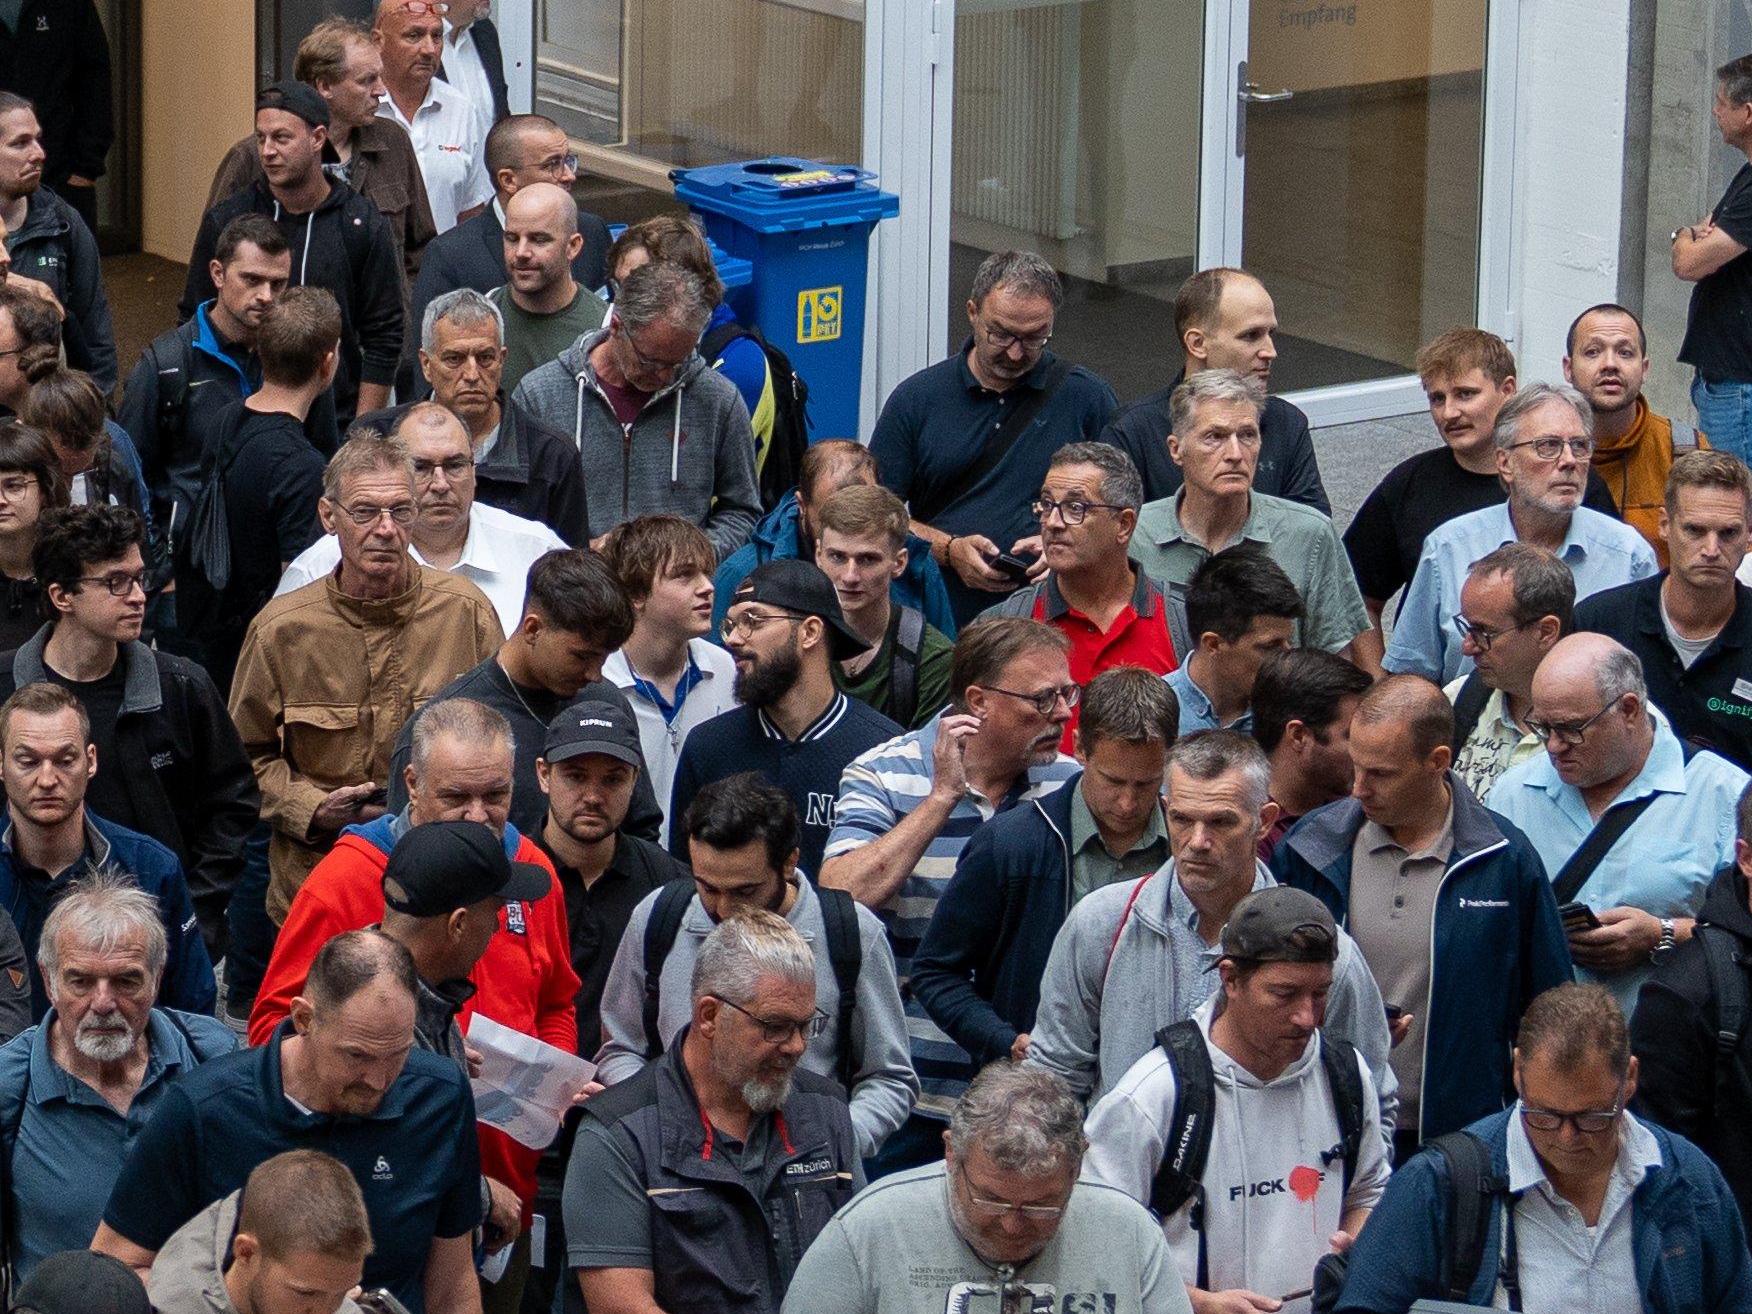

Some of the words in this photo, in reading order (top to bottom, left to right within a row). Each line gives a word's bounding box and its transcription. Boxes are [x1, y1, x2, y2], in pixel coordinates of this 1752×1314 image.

[579, 719, 613, 728] KIPRUN
[1173, 1113, 1198, 1172] DAKINE
[1228, 1179, 1289, 1202] FUCK
